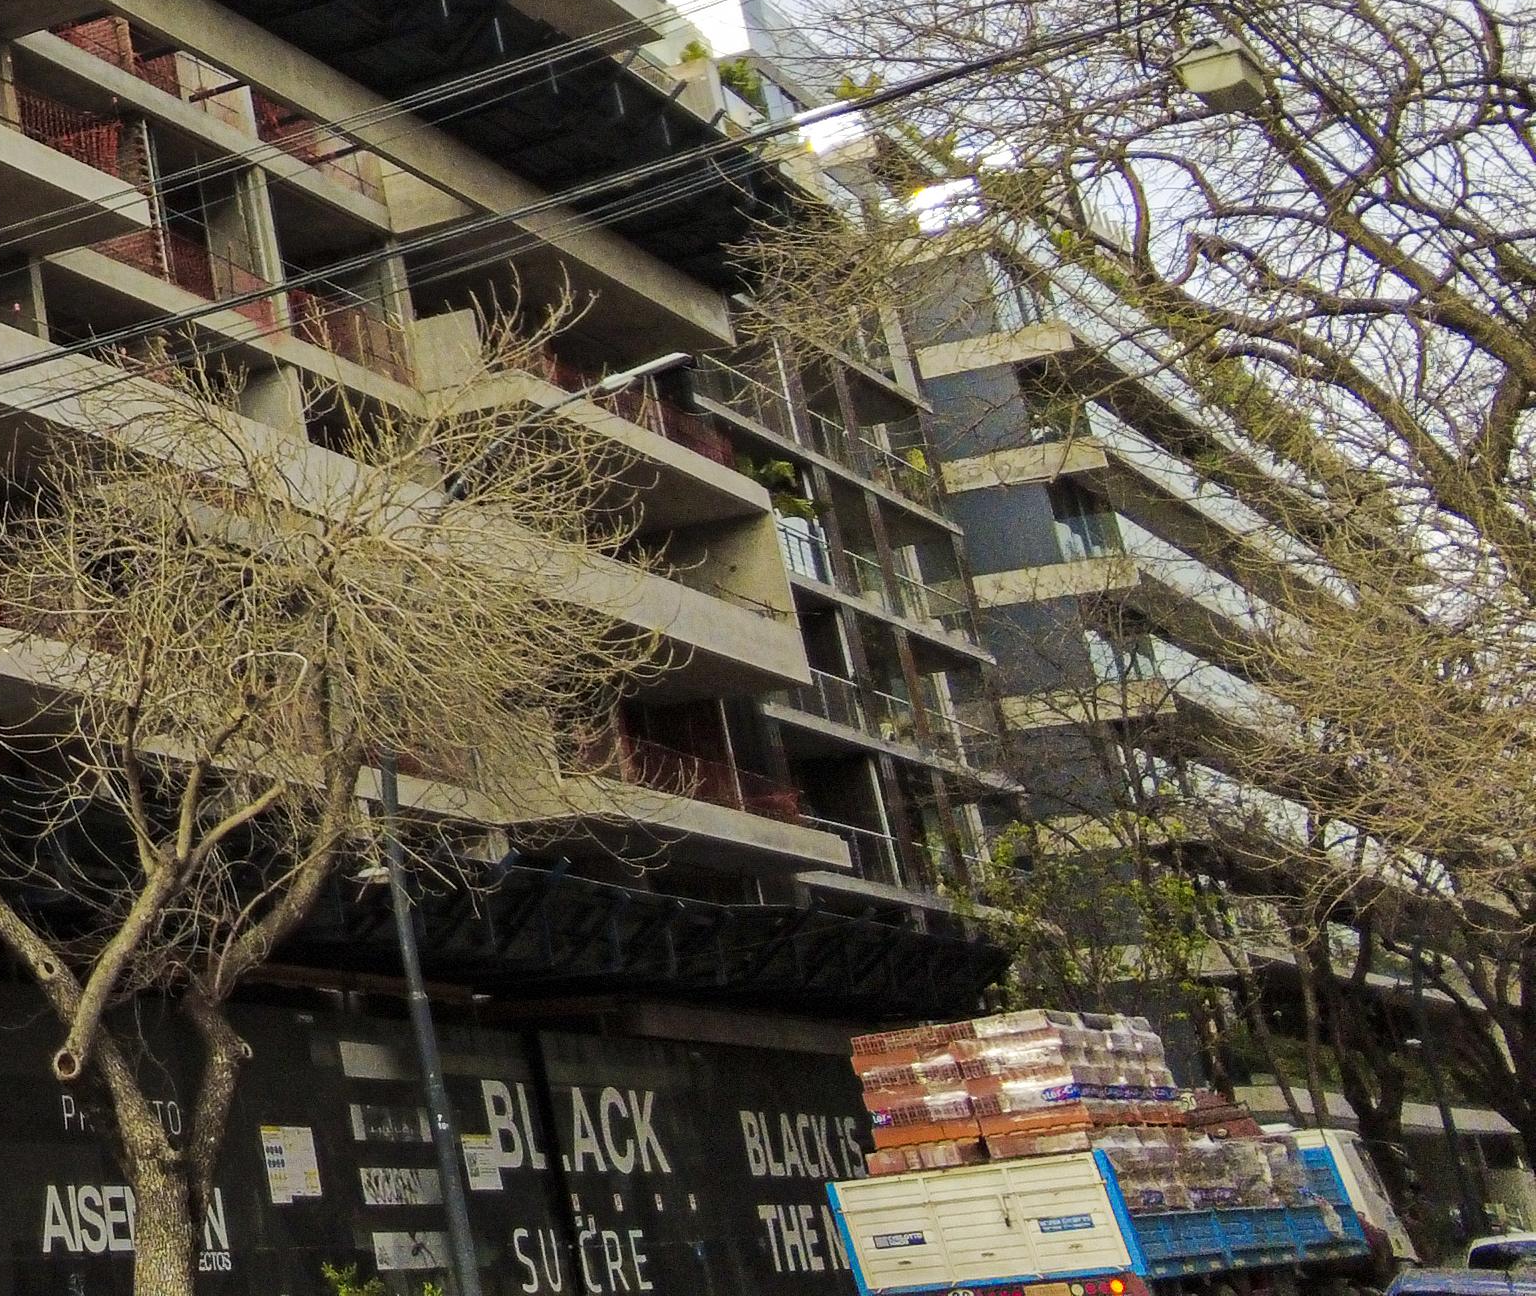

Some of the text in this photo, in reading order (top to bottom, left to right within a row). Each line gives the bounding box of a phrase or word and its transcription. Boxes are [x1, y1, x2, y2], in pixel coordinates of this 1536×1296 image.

[481, 1079, 672, 1174] BLACK
[739, 1110, 867, 1179] BLACK IS
[513, 1227, 654, 1293] SUCRE
[758, 1204, 825, 1272] THE
